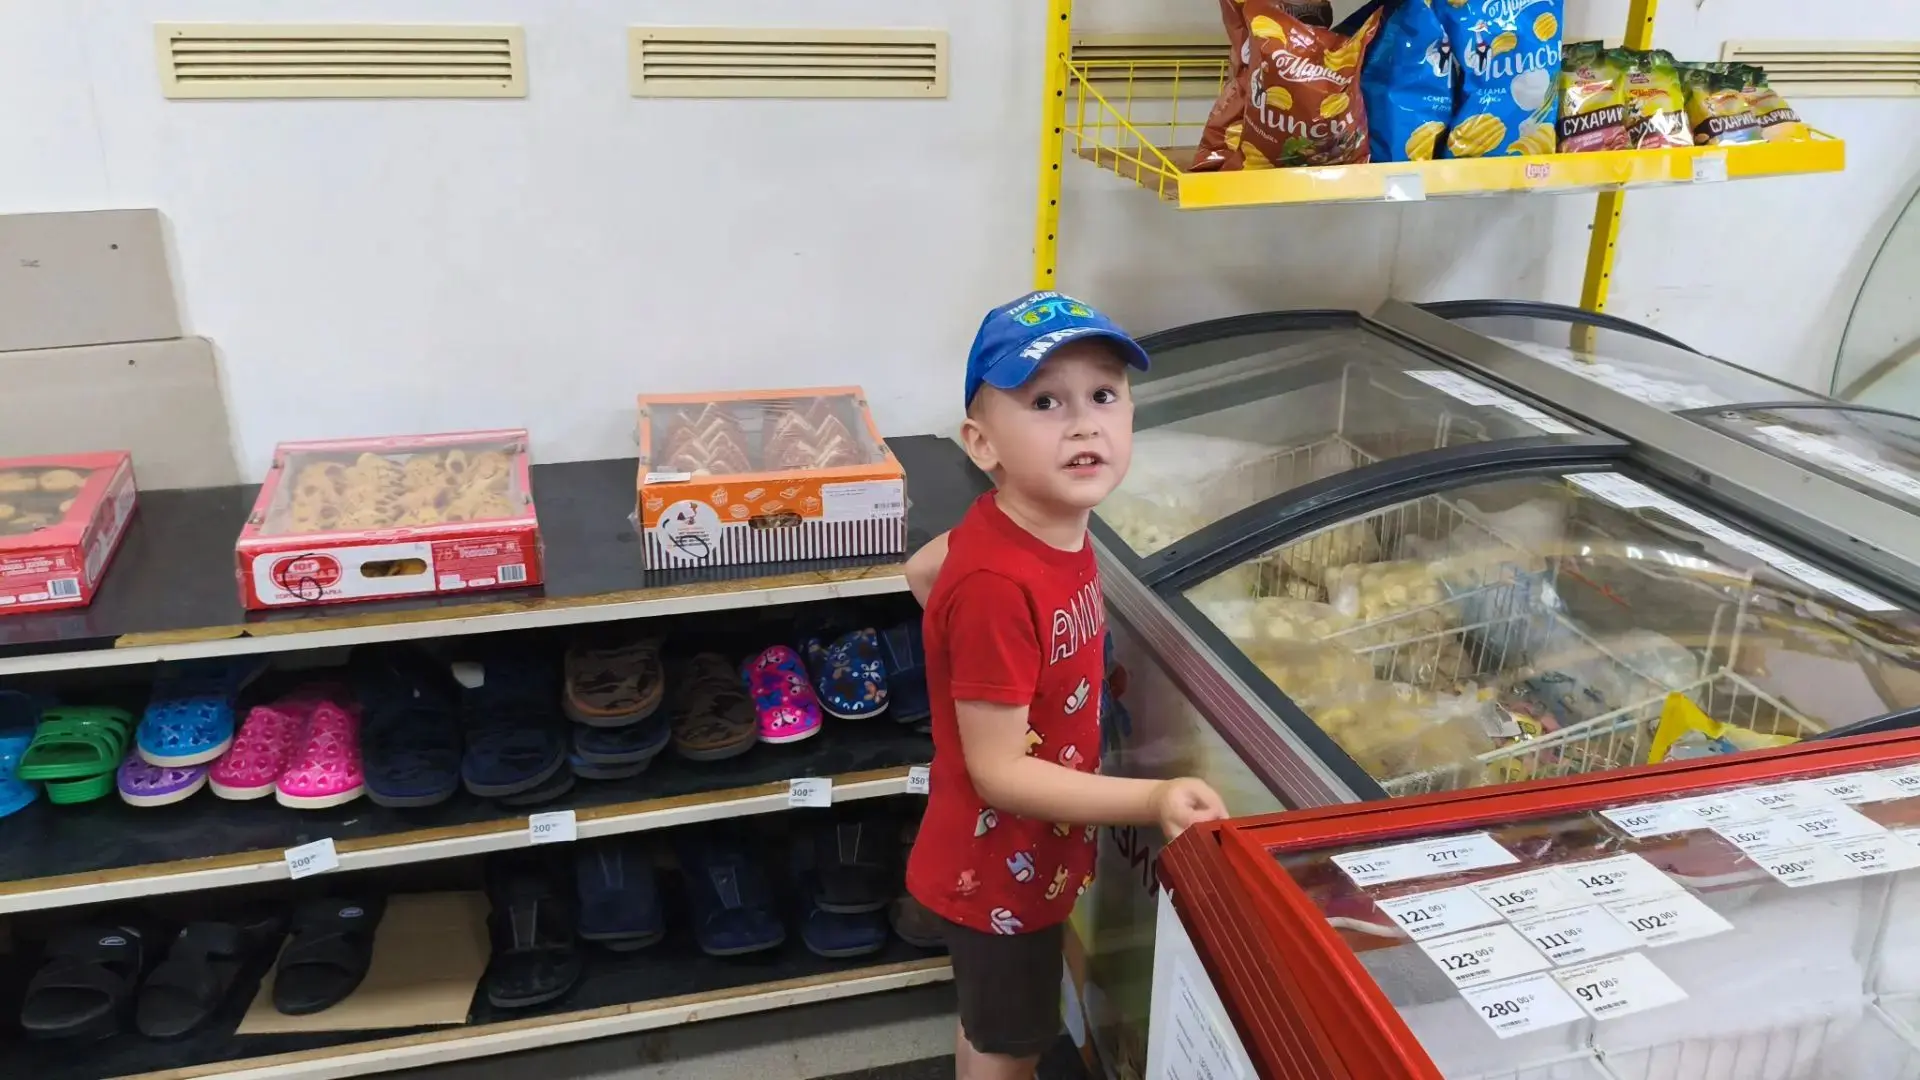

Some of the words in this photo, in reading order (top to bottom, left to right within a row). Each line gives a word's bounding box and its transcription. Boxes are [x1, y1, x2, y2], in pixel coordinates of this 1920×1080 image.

[910, 777, 925, 785] 350
[792, 789, 808, 797] 300
[533, 823, 551, 833] 200
[1619, 816, 1648, 828] 160
[1798, 821, 1828, 833] 153
[1730, 832, 1760, 843] 162
[1427, 849, 1458, 862] 277
[1844, 851, 1875, 863] 155
[291, 857, 310, 869] 200
[1348, 863, 1376, 874] 311
[1771, 863, 1804, 875] 280
[1578, 874, 1614, 888] 143
[1490, 892, 1524, 907] 116
[1398, 908, 1433, 925] 121
[1628, 915, 1667, 932] 102
[1536, 933, 1571, 949] 111
[1441, 952, 1479, 970] 123
[1576, 983, 1603, 1001] 97
[1481, 1000, 1520, 1019] 280
